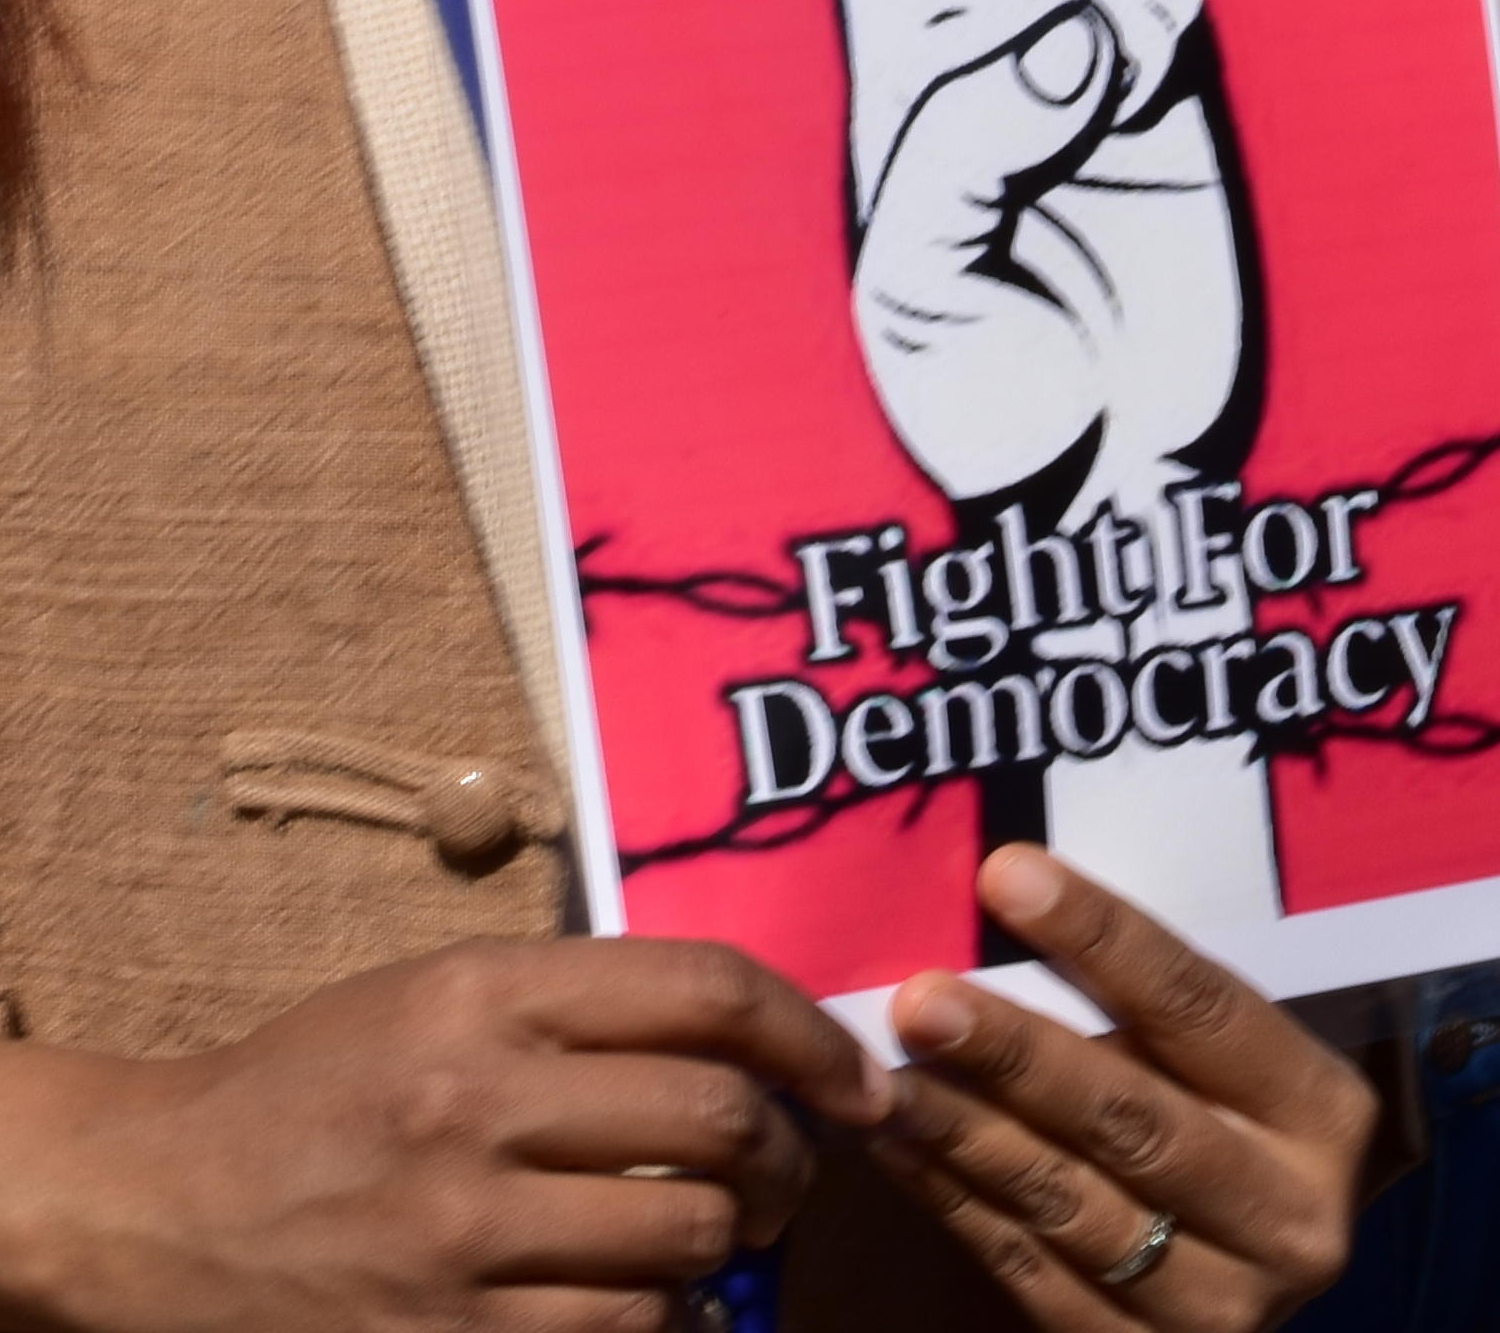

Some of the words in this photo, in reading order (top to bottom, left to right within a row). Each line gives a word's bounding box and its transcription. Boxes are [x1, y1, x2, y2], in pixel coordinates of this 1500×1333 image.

[797, 502, 1150, 673] Fight
[1166, 482, 1379, 608] For
[729, 603, 1459, 806] Democracy
